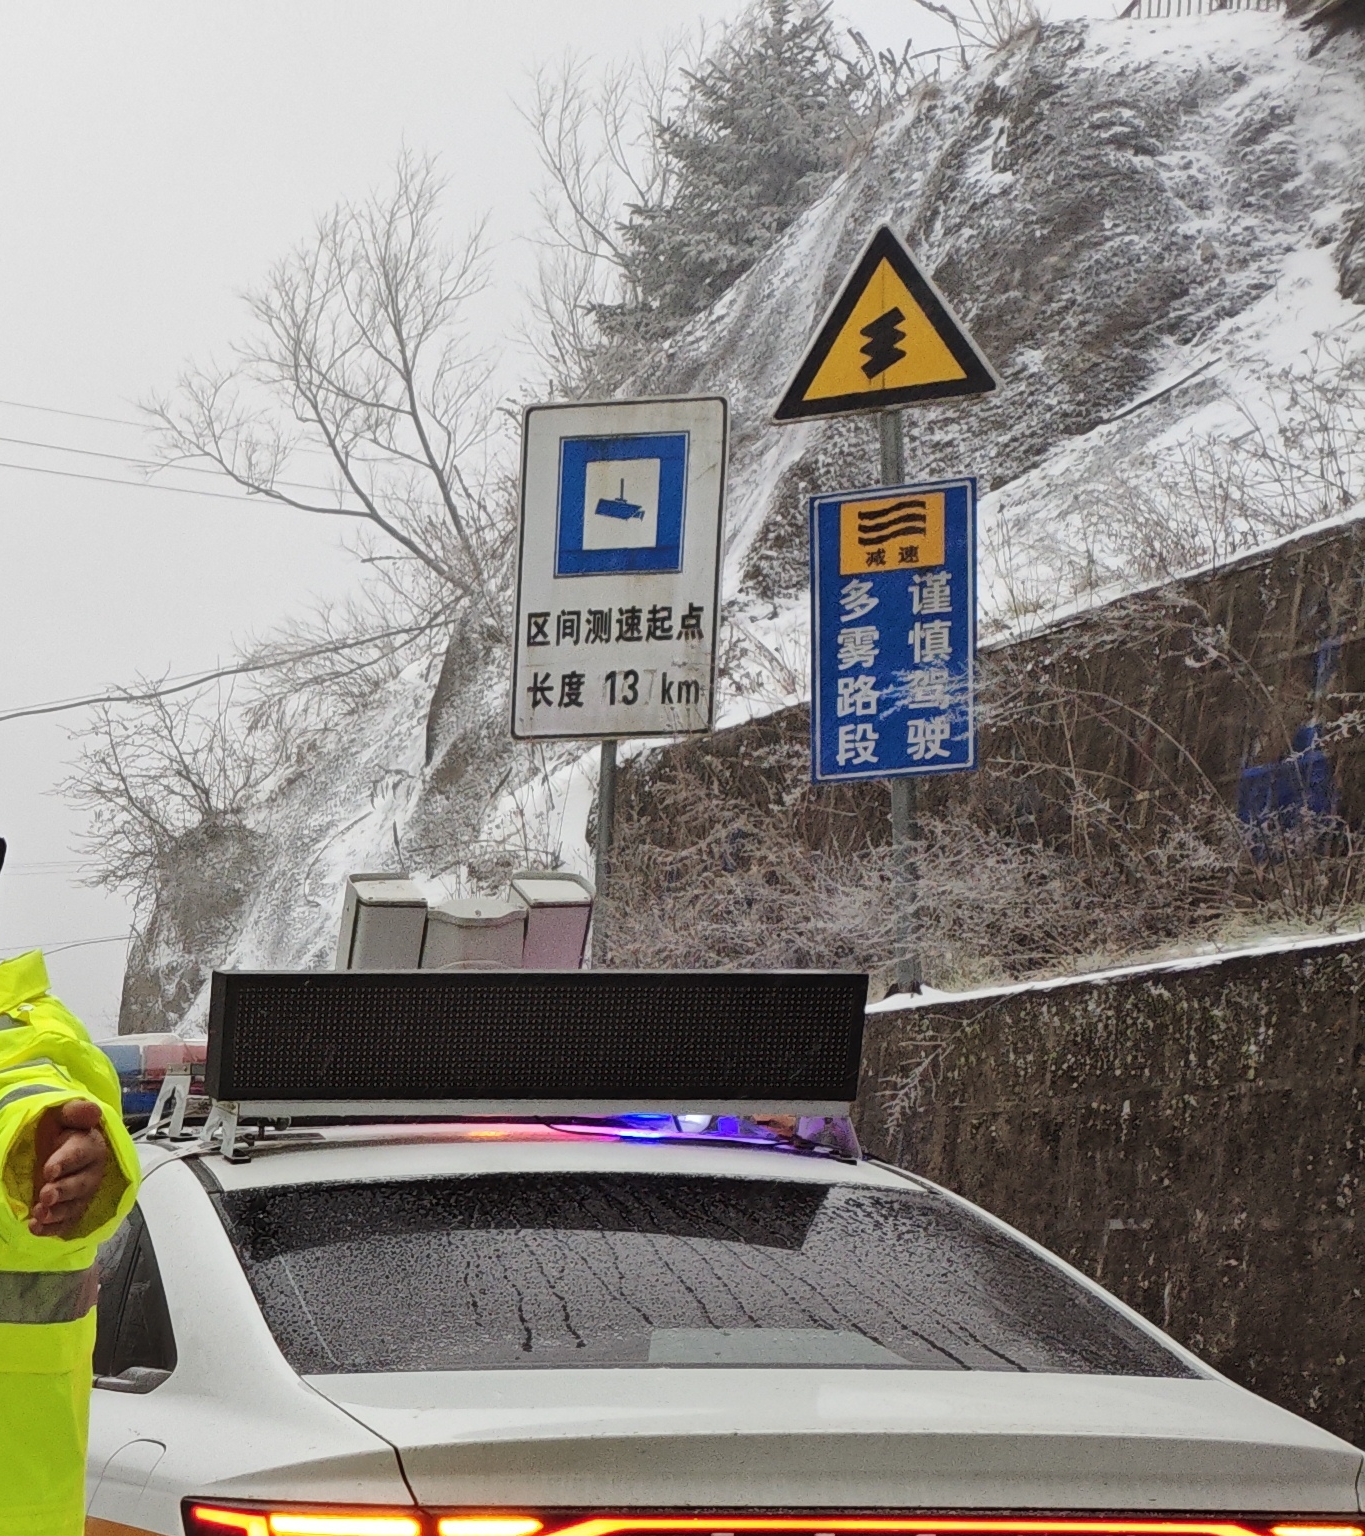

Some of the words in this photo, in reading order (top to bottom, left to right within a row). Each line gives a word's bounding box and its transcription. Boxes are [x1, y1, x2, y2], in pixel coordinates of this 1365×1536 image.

[866, 545, 920, 567] 减速
[526, 602, 705, 648] 区间测速起点
[526, 670, 587, 709] 长度
[604, 668, 639, 706] 13
[660, 671, 700, 705] km
[836, 579, 880, 767] 多雾路段
[907, 570, 953, 761] 谨慎驾驶
